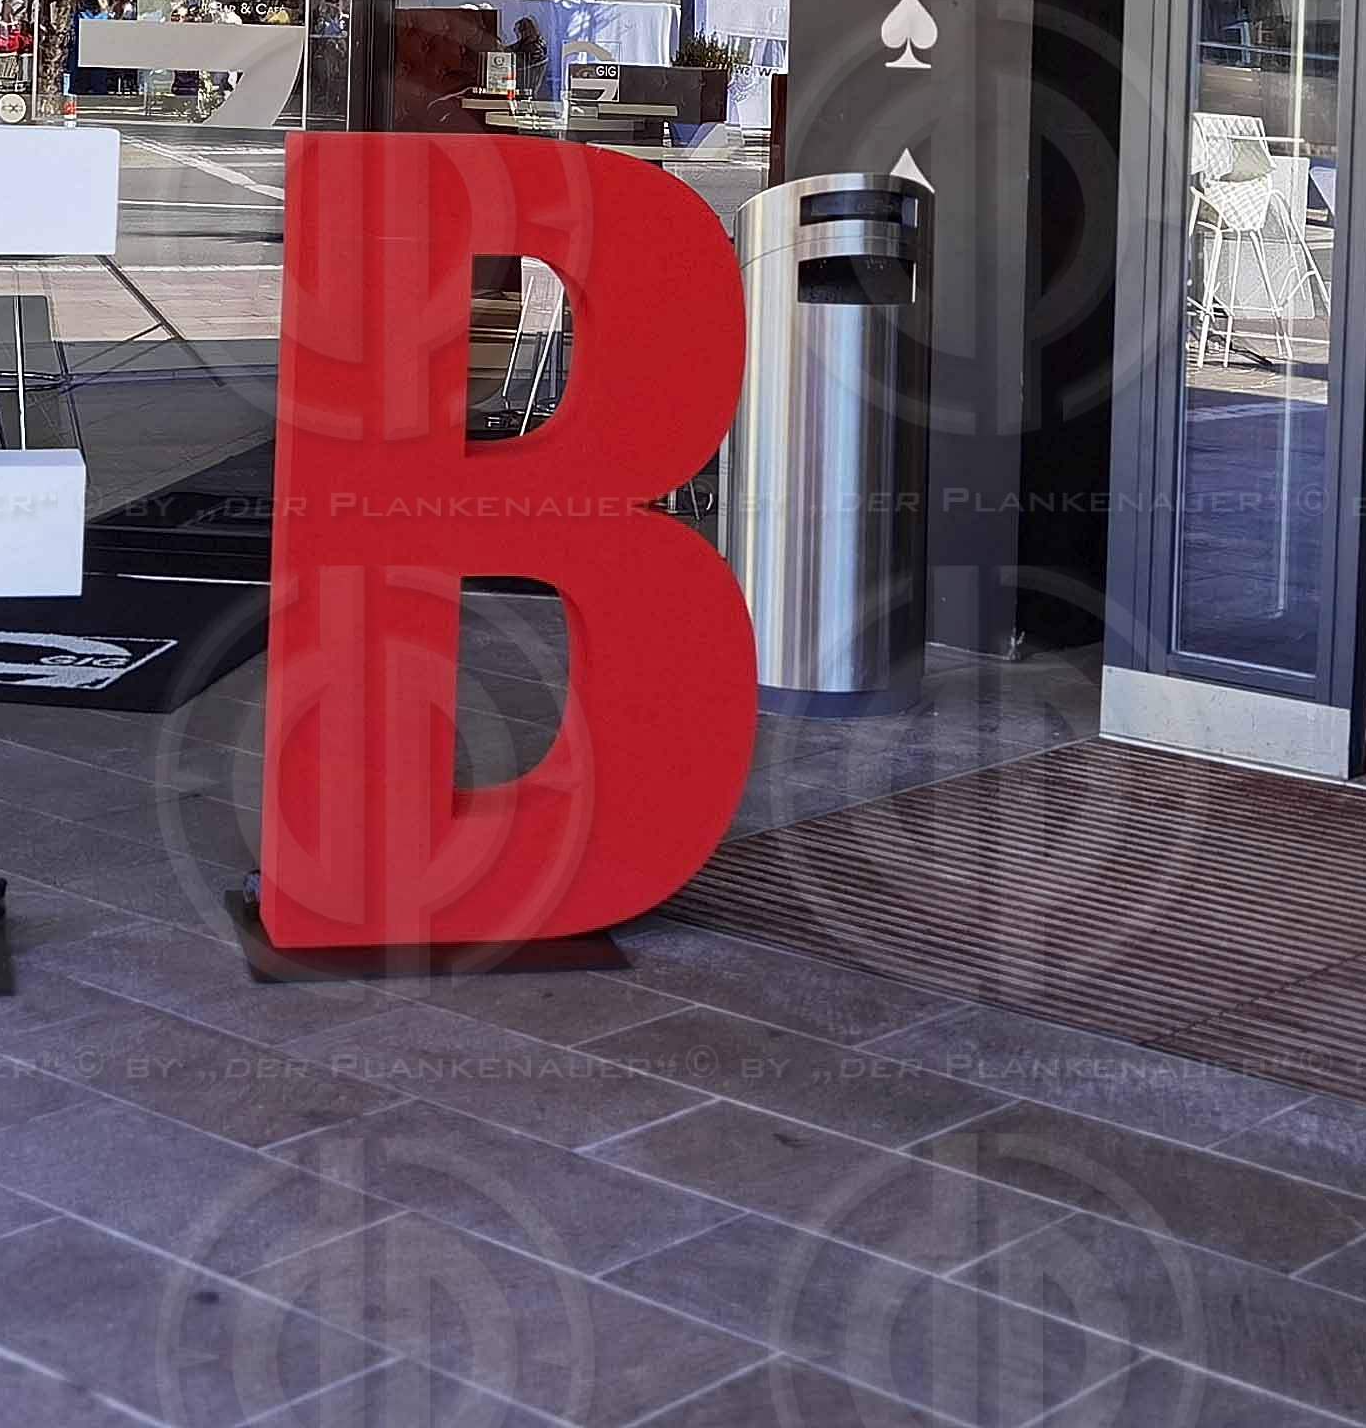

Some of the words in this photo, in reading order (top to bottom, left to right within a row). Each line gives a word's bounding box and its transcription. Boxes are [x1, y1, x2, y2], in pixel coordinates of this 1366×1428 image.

[240, 2, 252, 14] &
[595, 65, 617, 78] GIG
[39, 655, 128, 667] GIG
